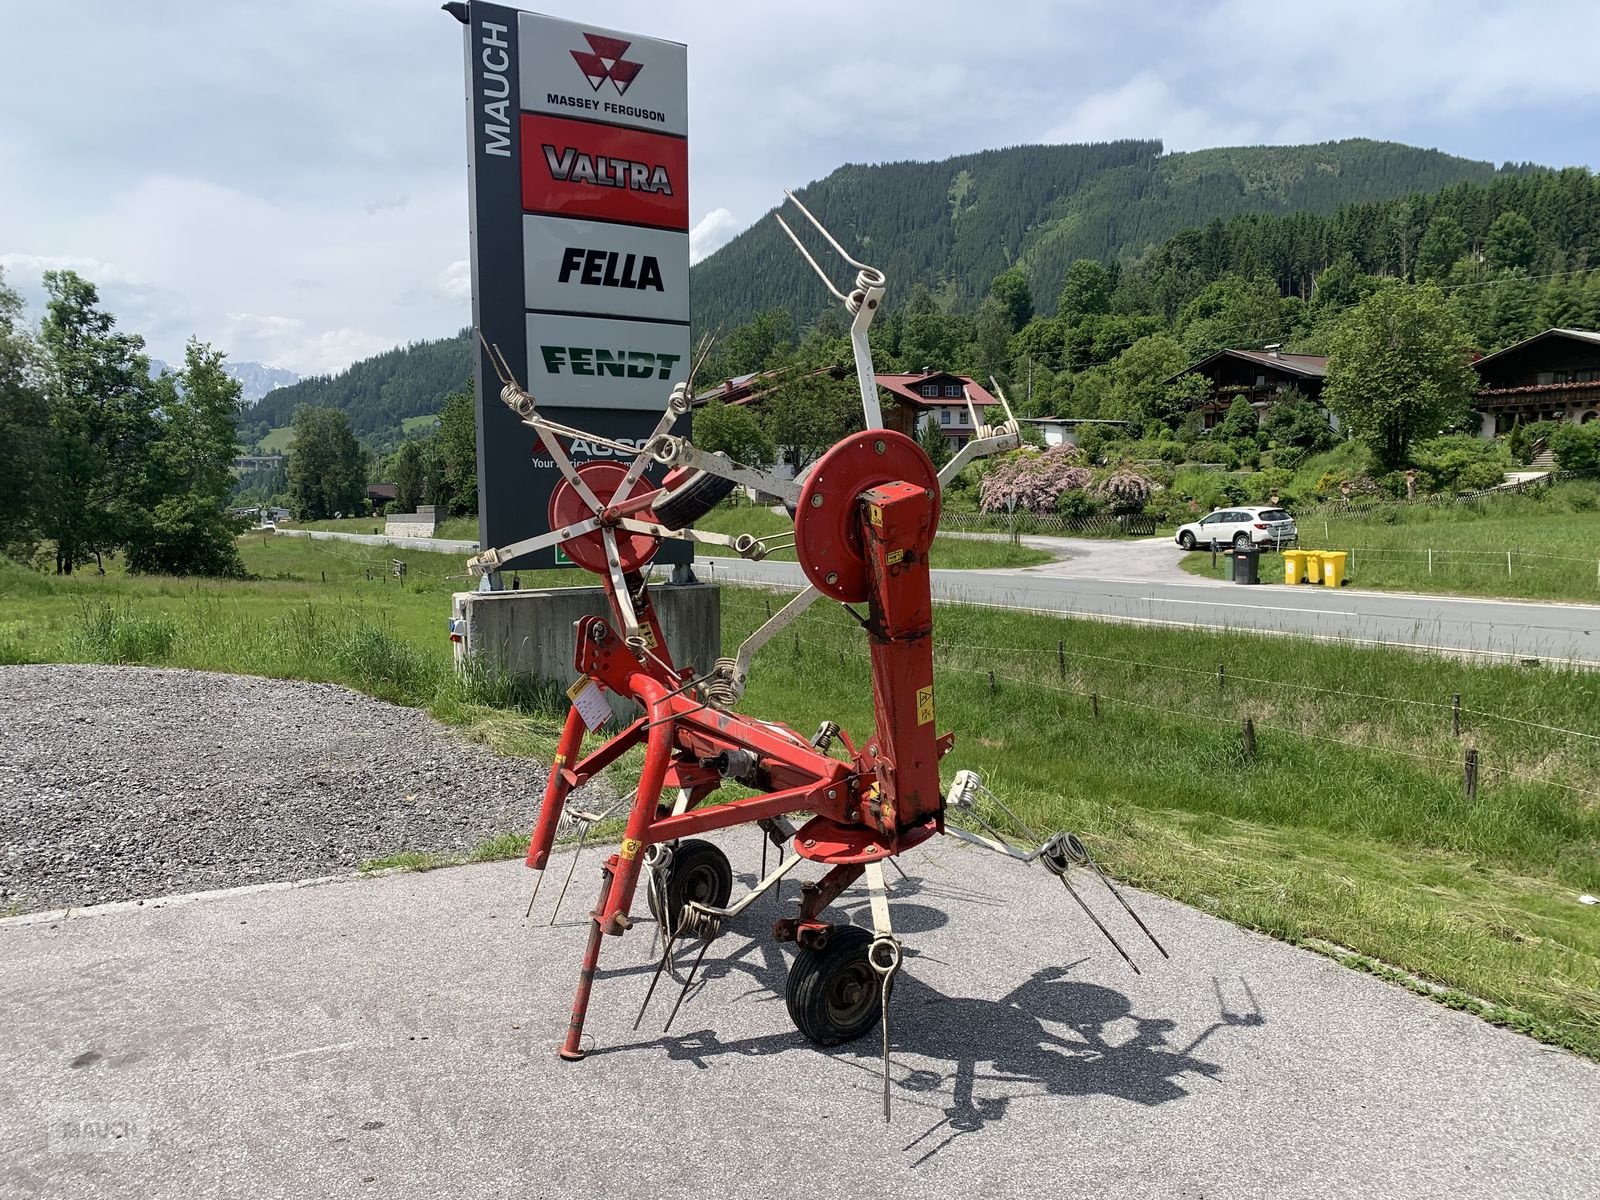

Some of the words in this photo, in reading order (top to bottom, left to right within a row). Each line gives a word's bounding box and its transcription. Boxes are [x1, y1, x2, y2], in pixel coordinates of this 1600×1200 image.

[482, 21, 511, 157] MAUCH
[547, 93, 600, 111] MASSEY
[604, 102, 665, 123] FERGUSON
[541, 144, 673, 196] VALTRA
[558, 247, 665, 292] FELLA
[540, 345, 681, 381] FENDT
[532, 458, 554, 469] Your
